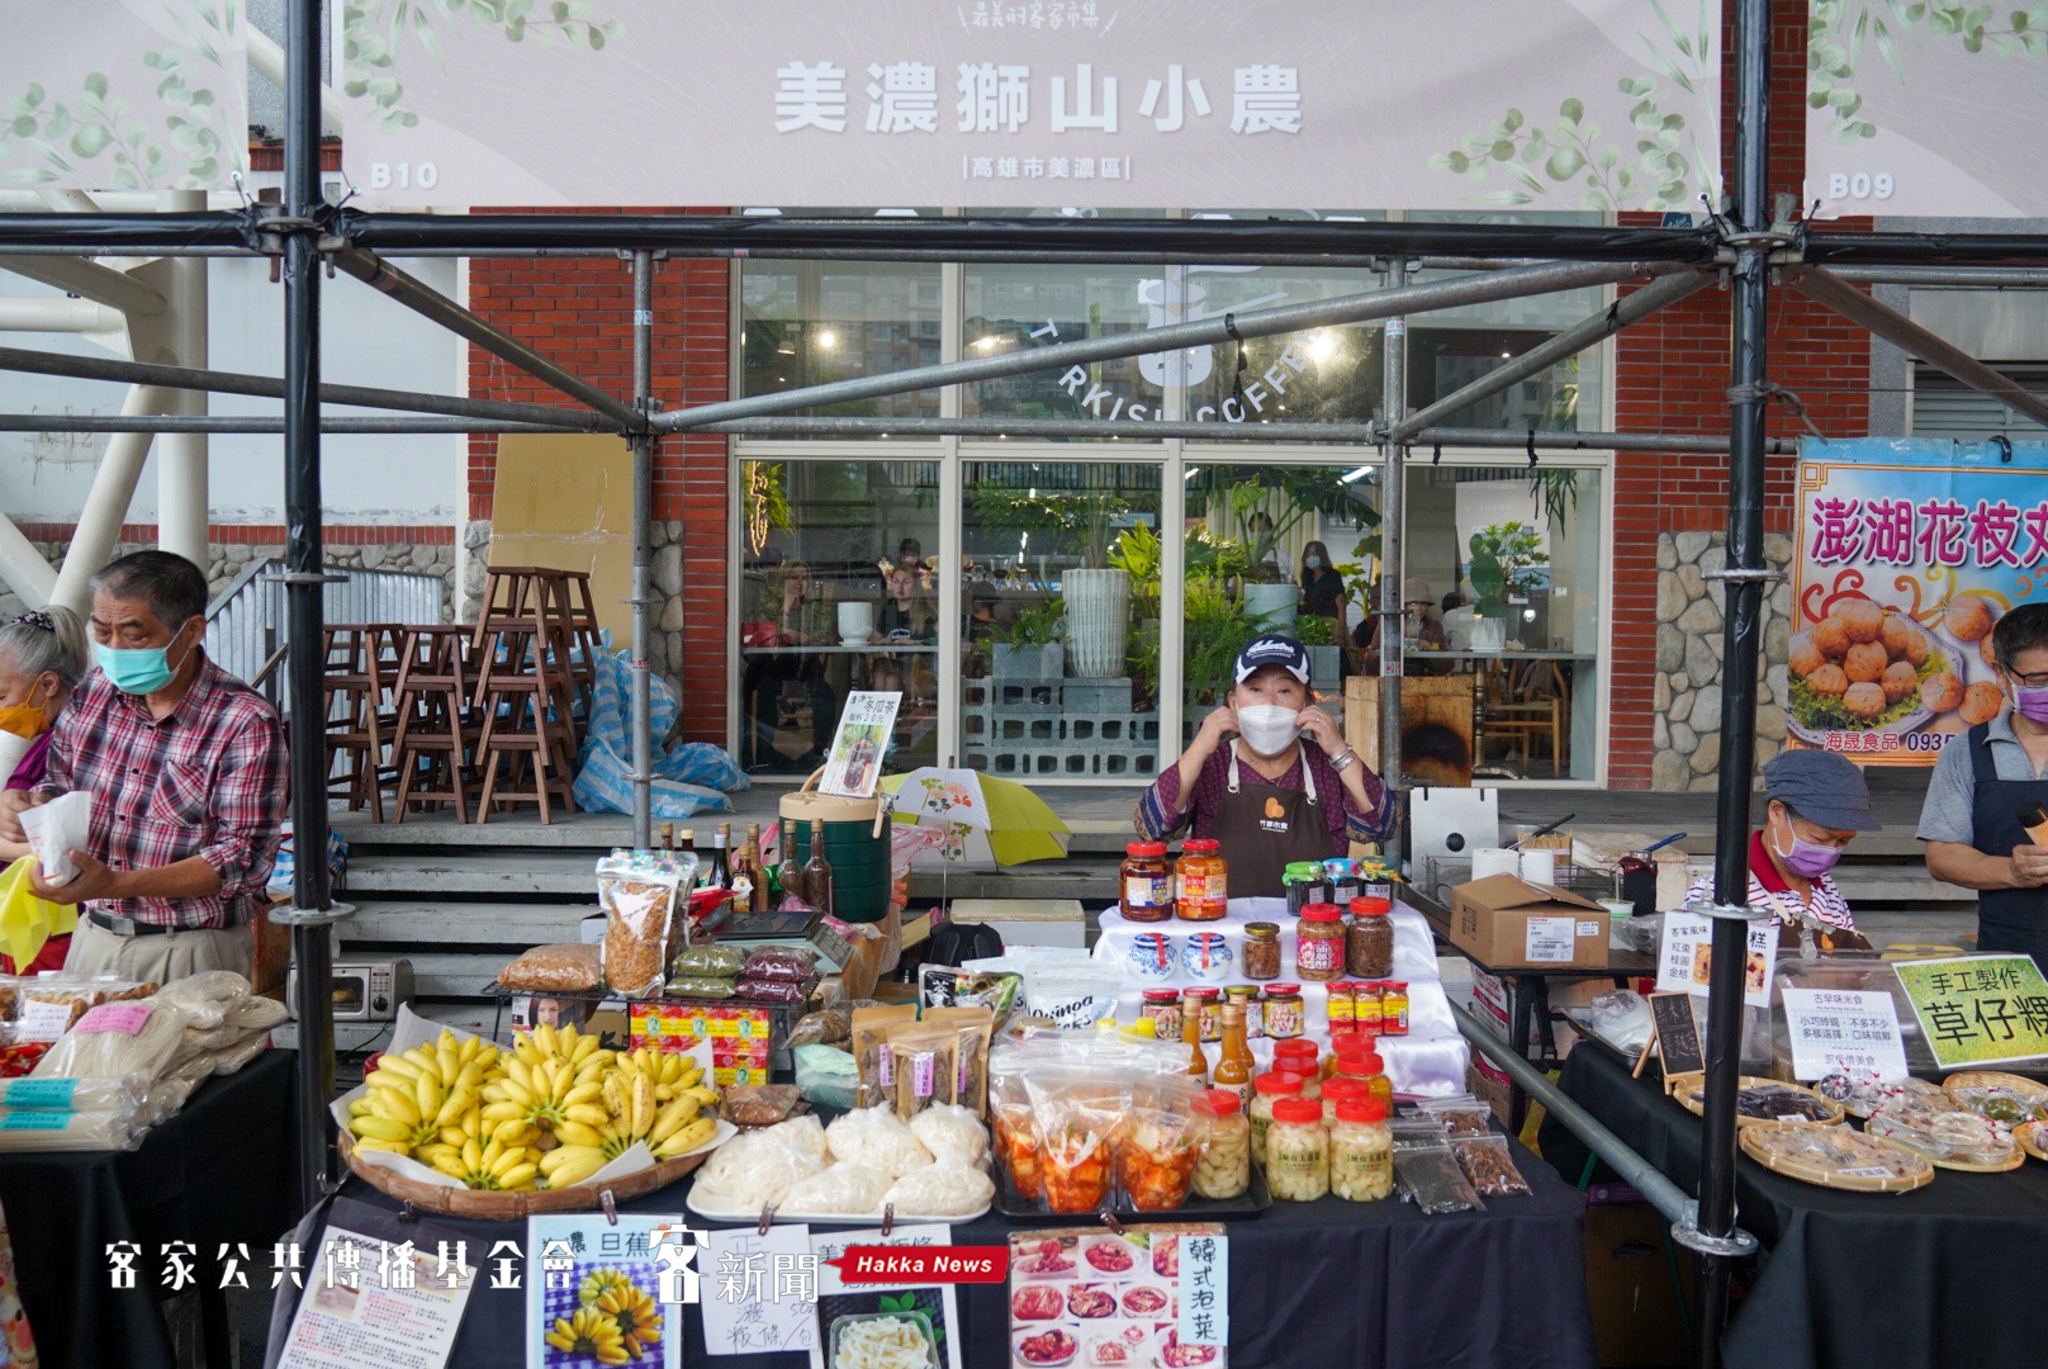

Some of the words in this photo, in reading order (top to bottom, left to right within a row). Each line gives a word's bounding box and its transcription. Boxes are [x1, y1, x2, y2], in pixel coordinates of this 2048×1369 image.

[774, 60, 1303, 135] 美濃獅山小農
[370, 162, 440, 190] B10
[971, 156, 1122, 180] 高雄市美濃區
[1828, 172, 1895, 200] B09
[1030, 317, 1177, 421] TRKIS
[1670, 925, 1708, 938] 客家風味
[1930, 967, 2021, 996] 手工製作
[1813, 993, 1863, 1005] 古早味米食
[1923, 994, 2048, 1046] 草仔粿
[1188, 1238, 1218, 1341] 韓式泡菜
